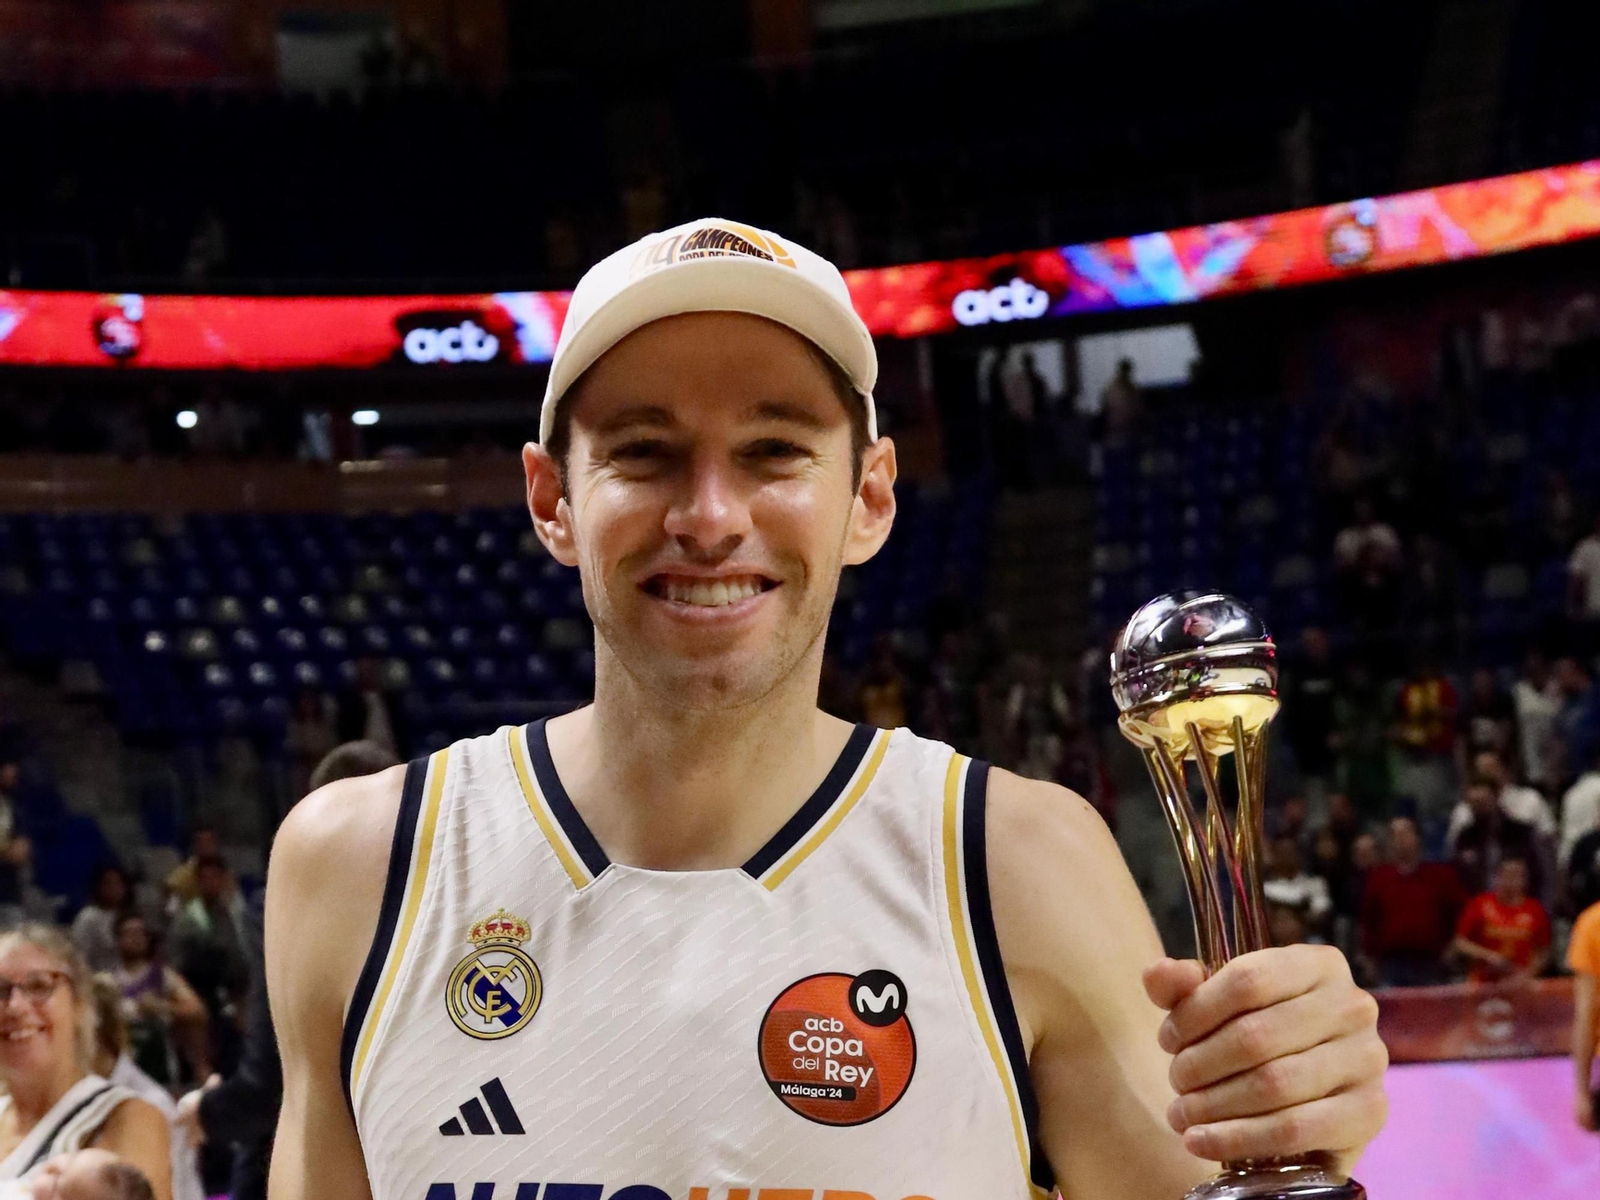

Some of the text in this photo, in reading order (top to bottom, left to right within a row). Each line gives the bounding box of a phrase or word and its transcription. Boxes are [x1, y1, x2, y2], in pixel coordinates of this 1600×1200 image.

[680, 228, 774, 262] CAMPEONES
[952, 277, 1049, 326] acb
[403, 320, 499, 364] acb
[804, 1017, 845, 1033] acb
[788, 1030, 863, 1058] Copa
[792, 1056, 874, 1088] del Rey
